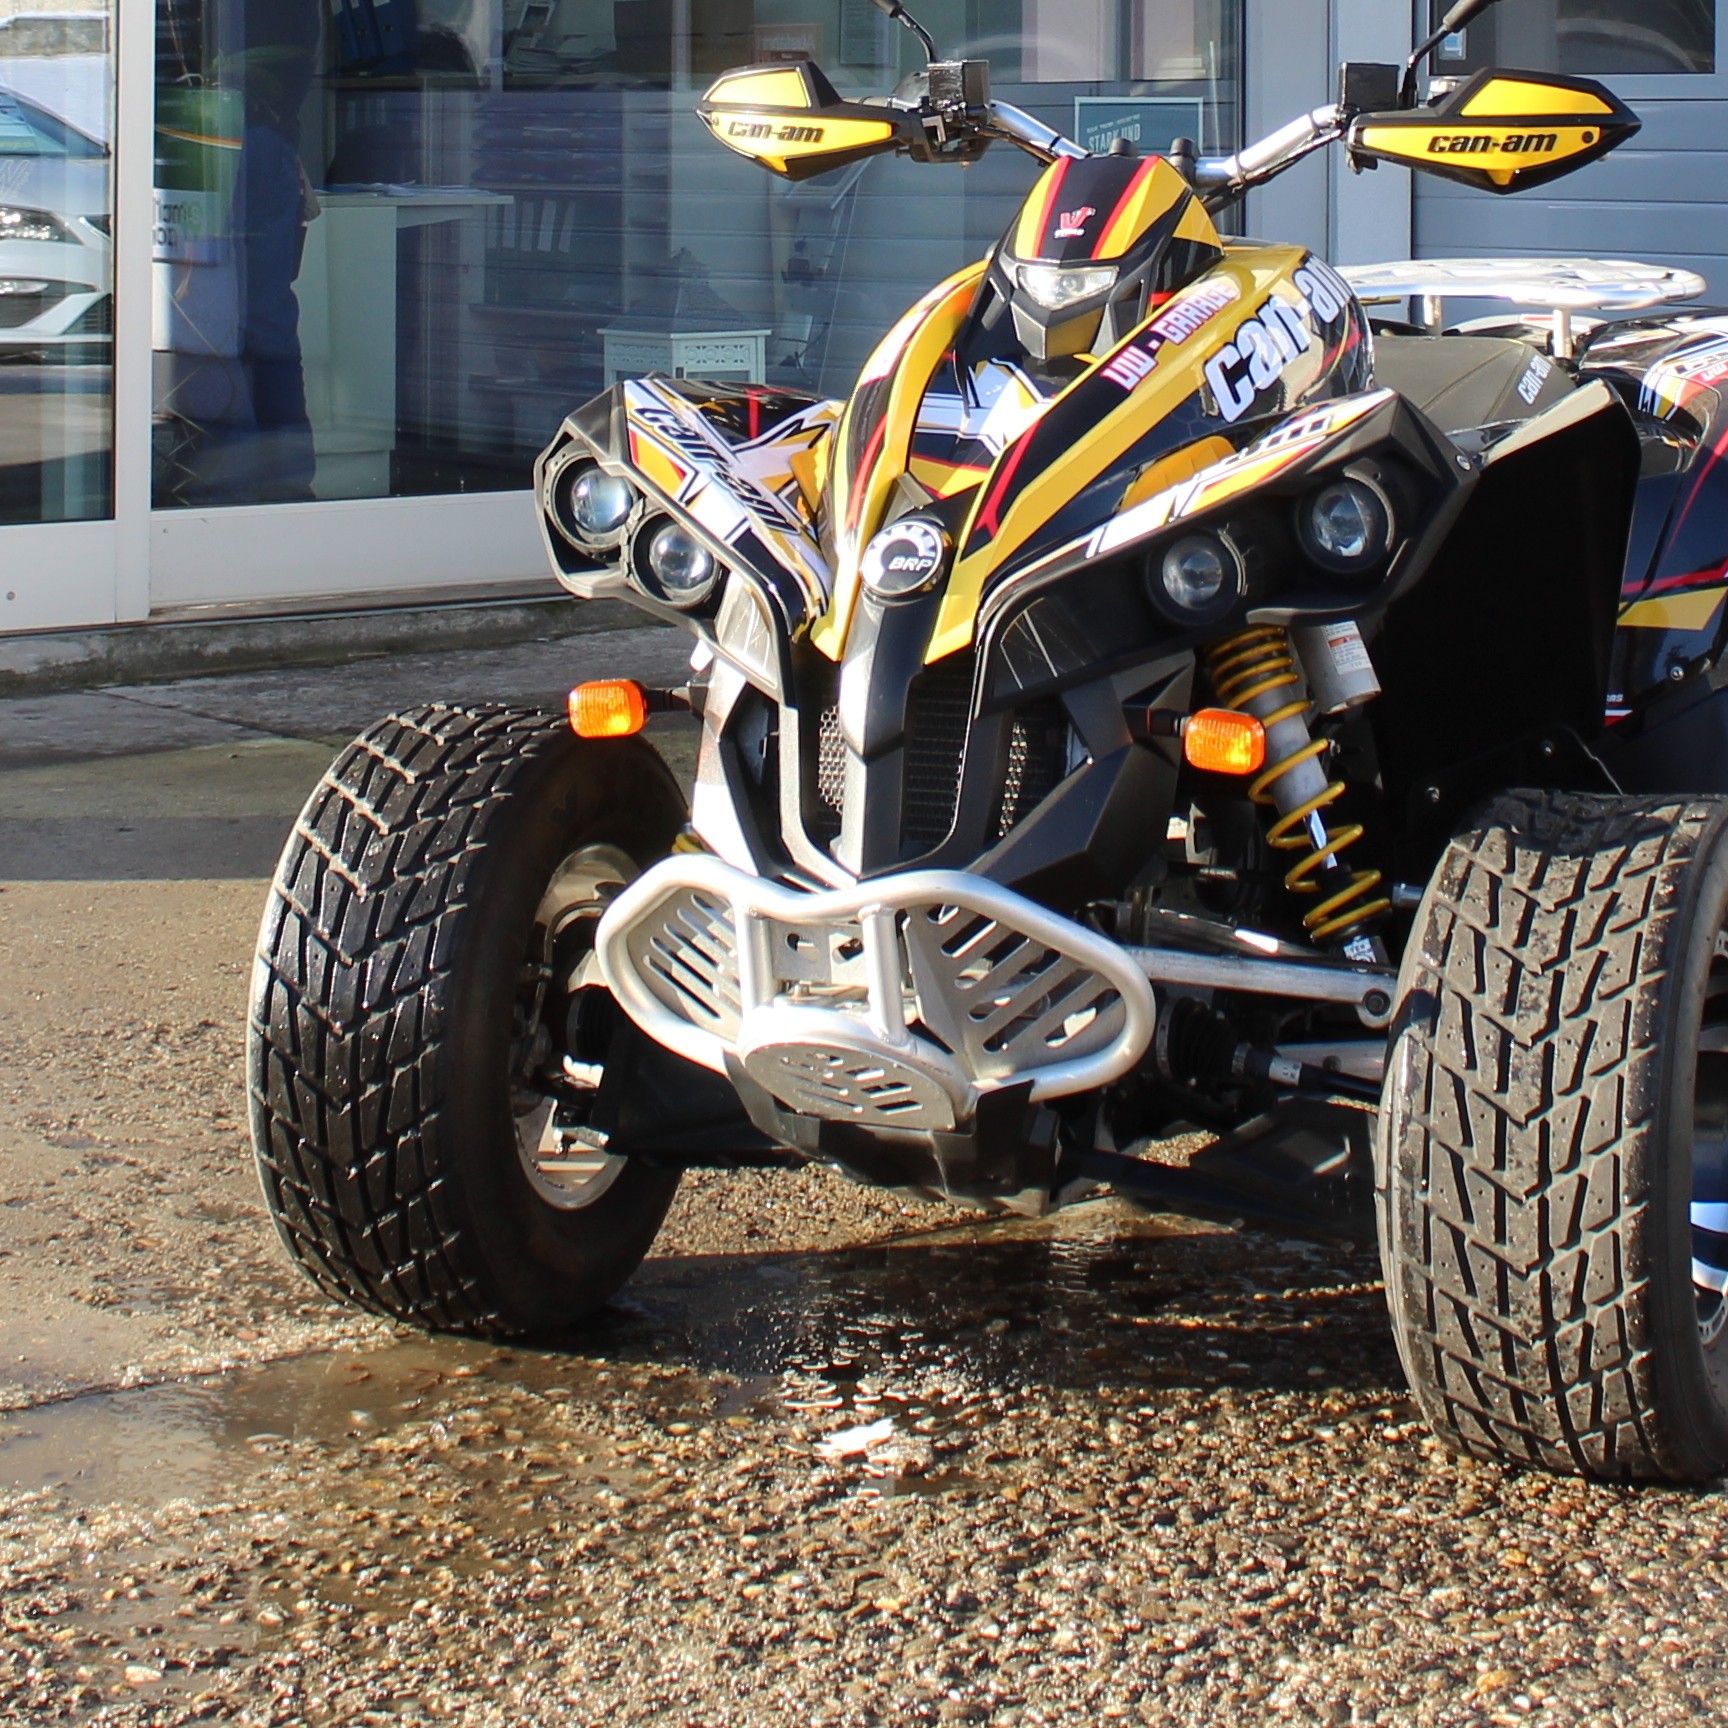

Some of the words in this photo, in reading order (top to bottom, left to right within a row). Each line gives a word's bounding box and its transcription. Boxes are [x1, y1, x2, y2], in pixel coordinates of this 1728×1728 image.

[728, 121, 825, 143] can-am
[1427, 133, 1557, 153] can-am
[1149, 284, 1240, 346] GARAGE
[1204, 252, 1354, 423] can-am
[1516, 354, 1552, 405] can-am
[888, 555, 933, 571] BRP
